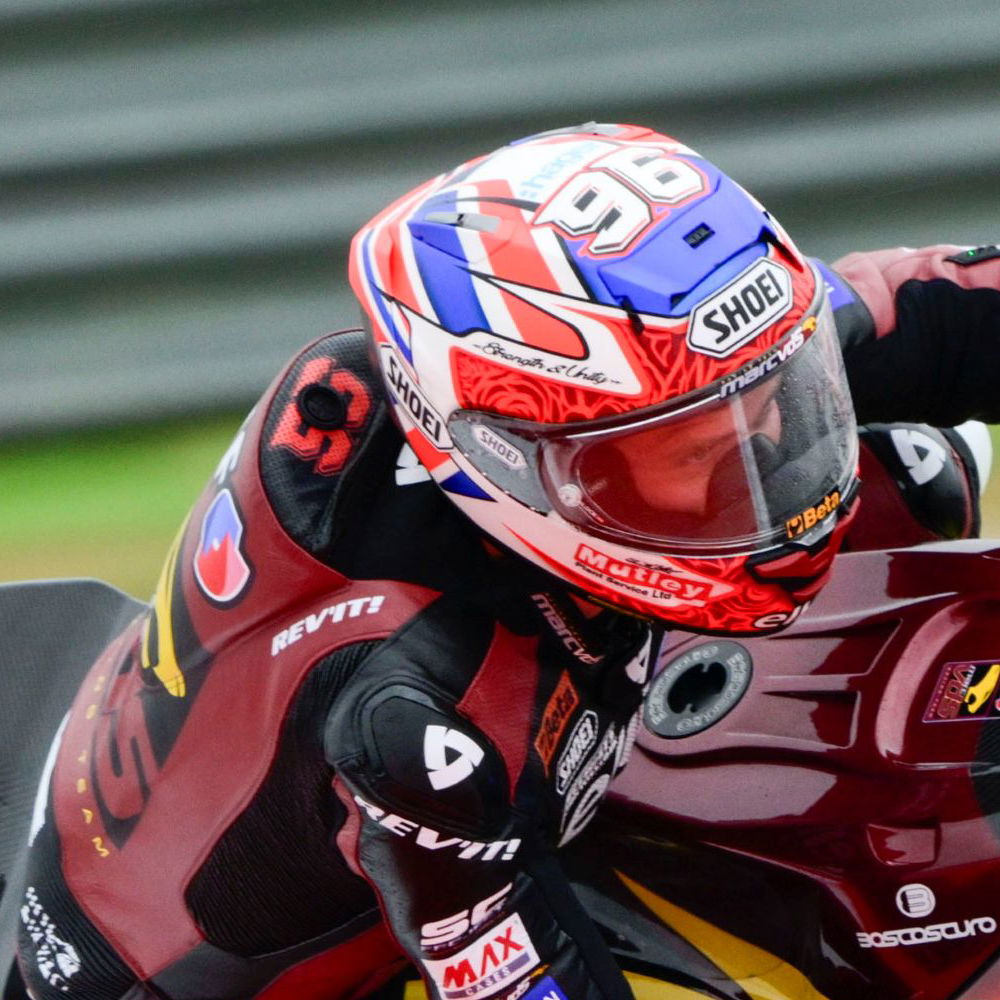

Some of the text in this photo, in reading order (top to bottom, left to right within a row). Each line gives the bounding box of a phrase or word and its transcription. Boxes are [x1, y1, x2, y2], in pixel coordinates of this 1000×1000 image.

[530, 145, 710, 260] 96
[702, 268, 785, 345] SHOEI
[386, 355, 442, 443] SHOEI
[479, 430, 520, 464] SHOEI
[803, 490, 842, 531] Beta
[577, 546, 705, 599] Mutley
[606, 576, 649, 597] Service
[652, 589, 672, 601] Ltd
[272, 596, 385, 657] REV'IT!
[442, 925, 525, 989] MAX
[466, 966, 513, 996] CASES
